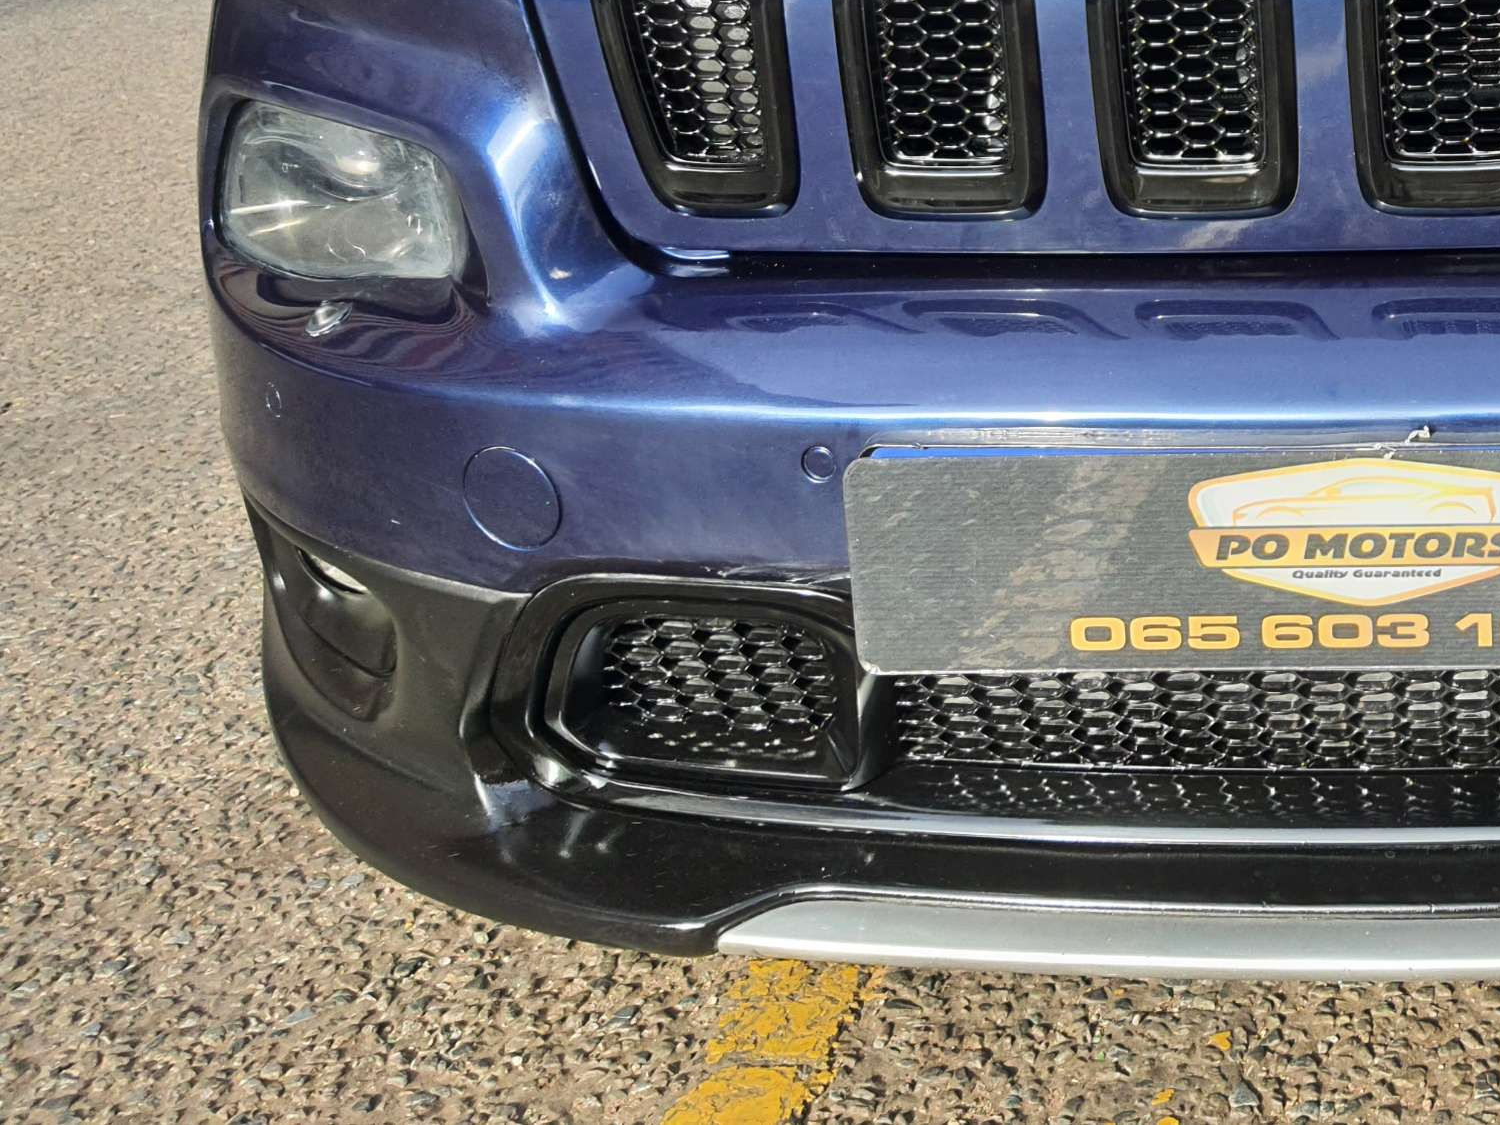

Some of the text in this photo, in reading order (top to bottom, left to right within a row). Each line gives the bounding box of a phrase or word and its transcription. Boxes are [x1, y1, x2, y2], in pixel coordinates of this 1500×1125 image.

[1215, 533, 1291, 561] PO
[1292, 567, 1442, 580] Quality Guaranteed
[1070, 615, 1242, 651] 065
[1261, 614, 1431, 650] 603
